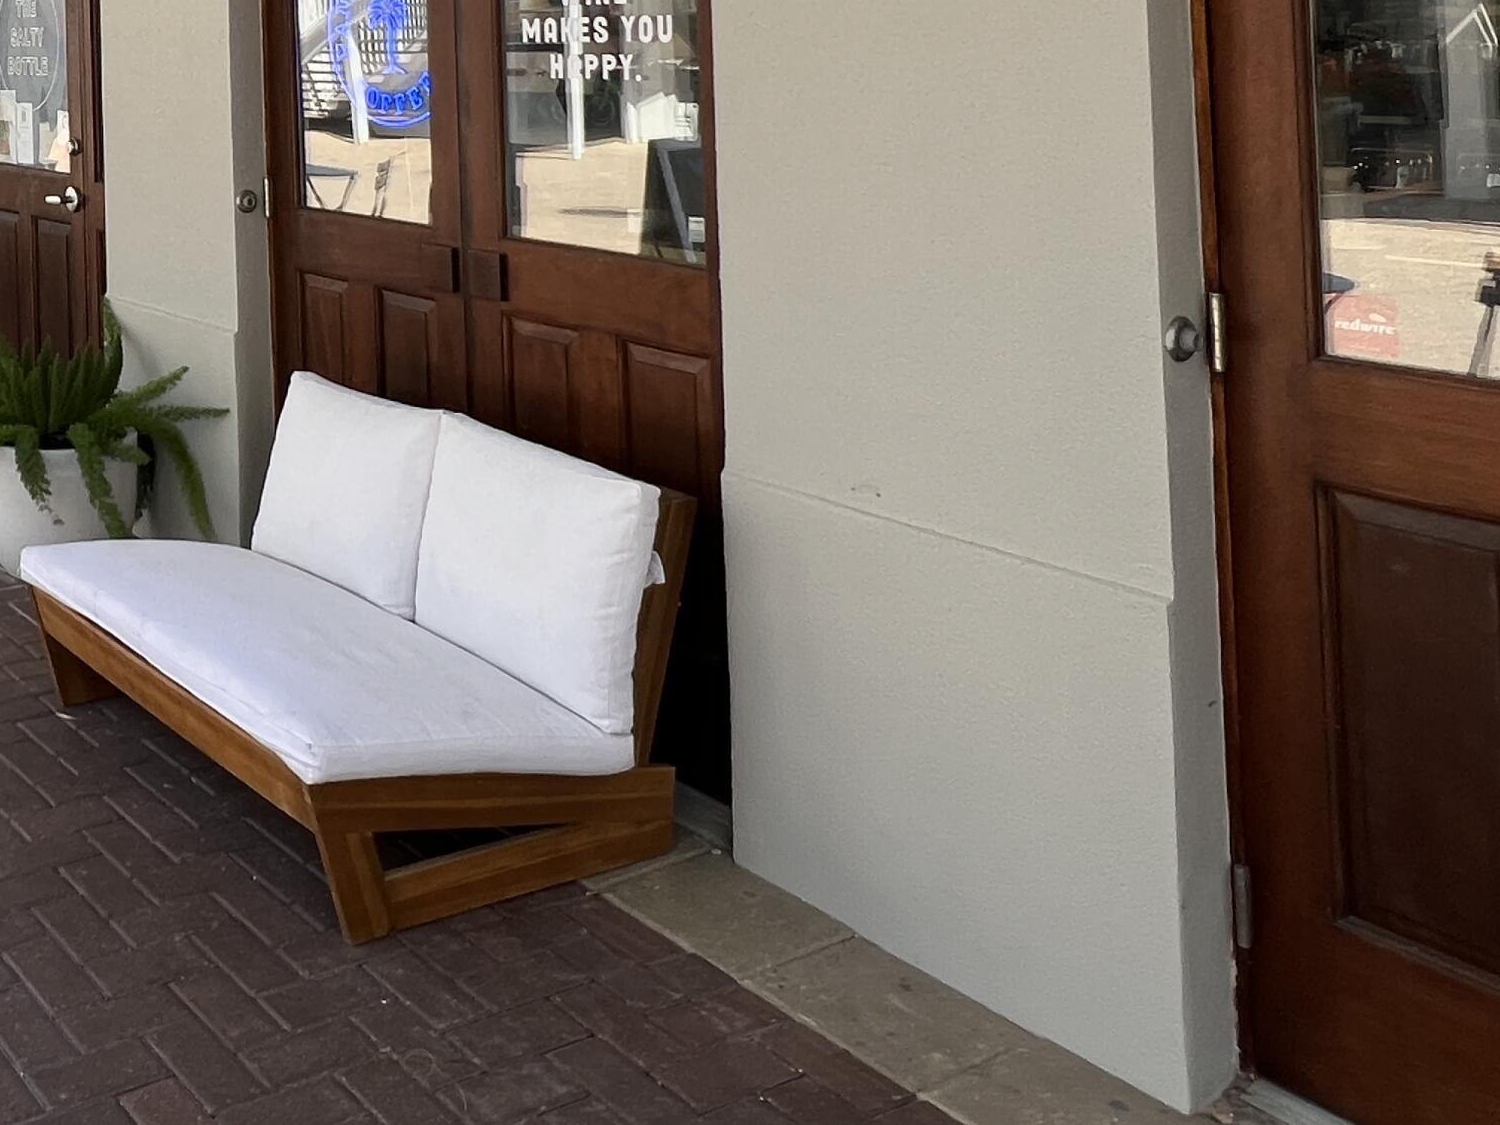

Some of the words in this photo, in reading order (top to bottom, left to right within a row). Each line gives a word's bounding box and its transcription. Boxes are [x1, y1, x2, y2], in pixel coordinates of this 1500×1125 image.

[10, 26, 45, 48] SALTY
[521, 17, 609, 44] MAKES
[622, 14, 673, 43] YOU
[7, 56, 49, 76] BOTTLE
[549, 53, 643, 82] HAPPY.
